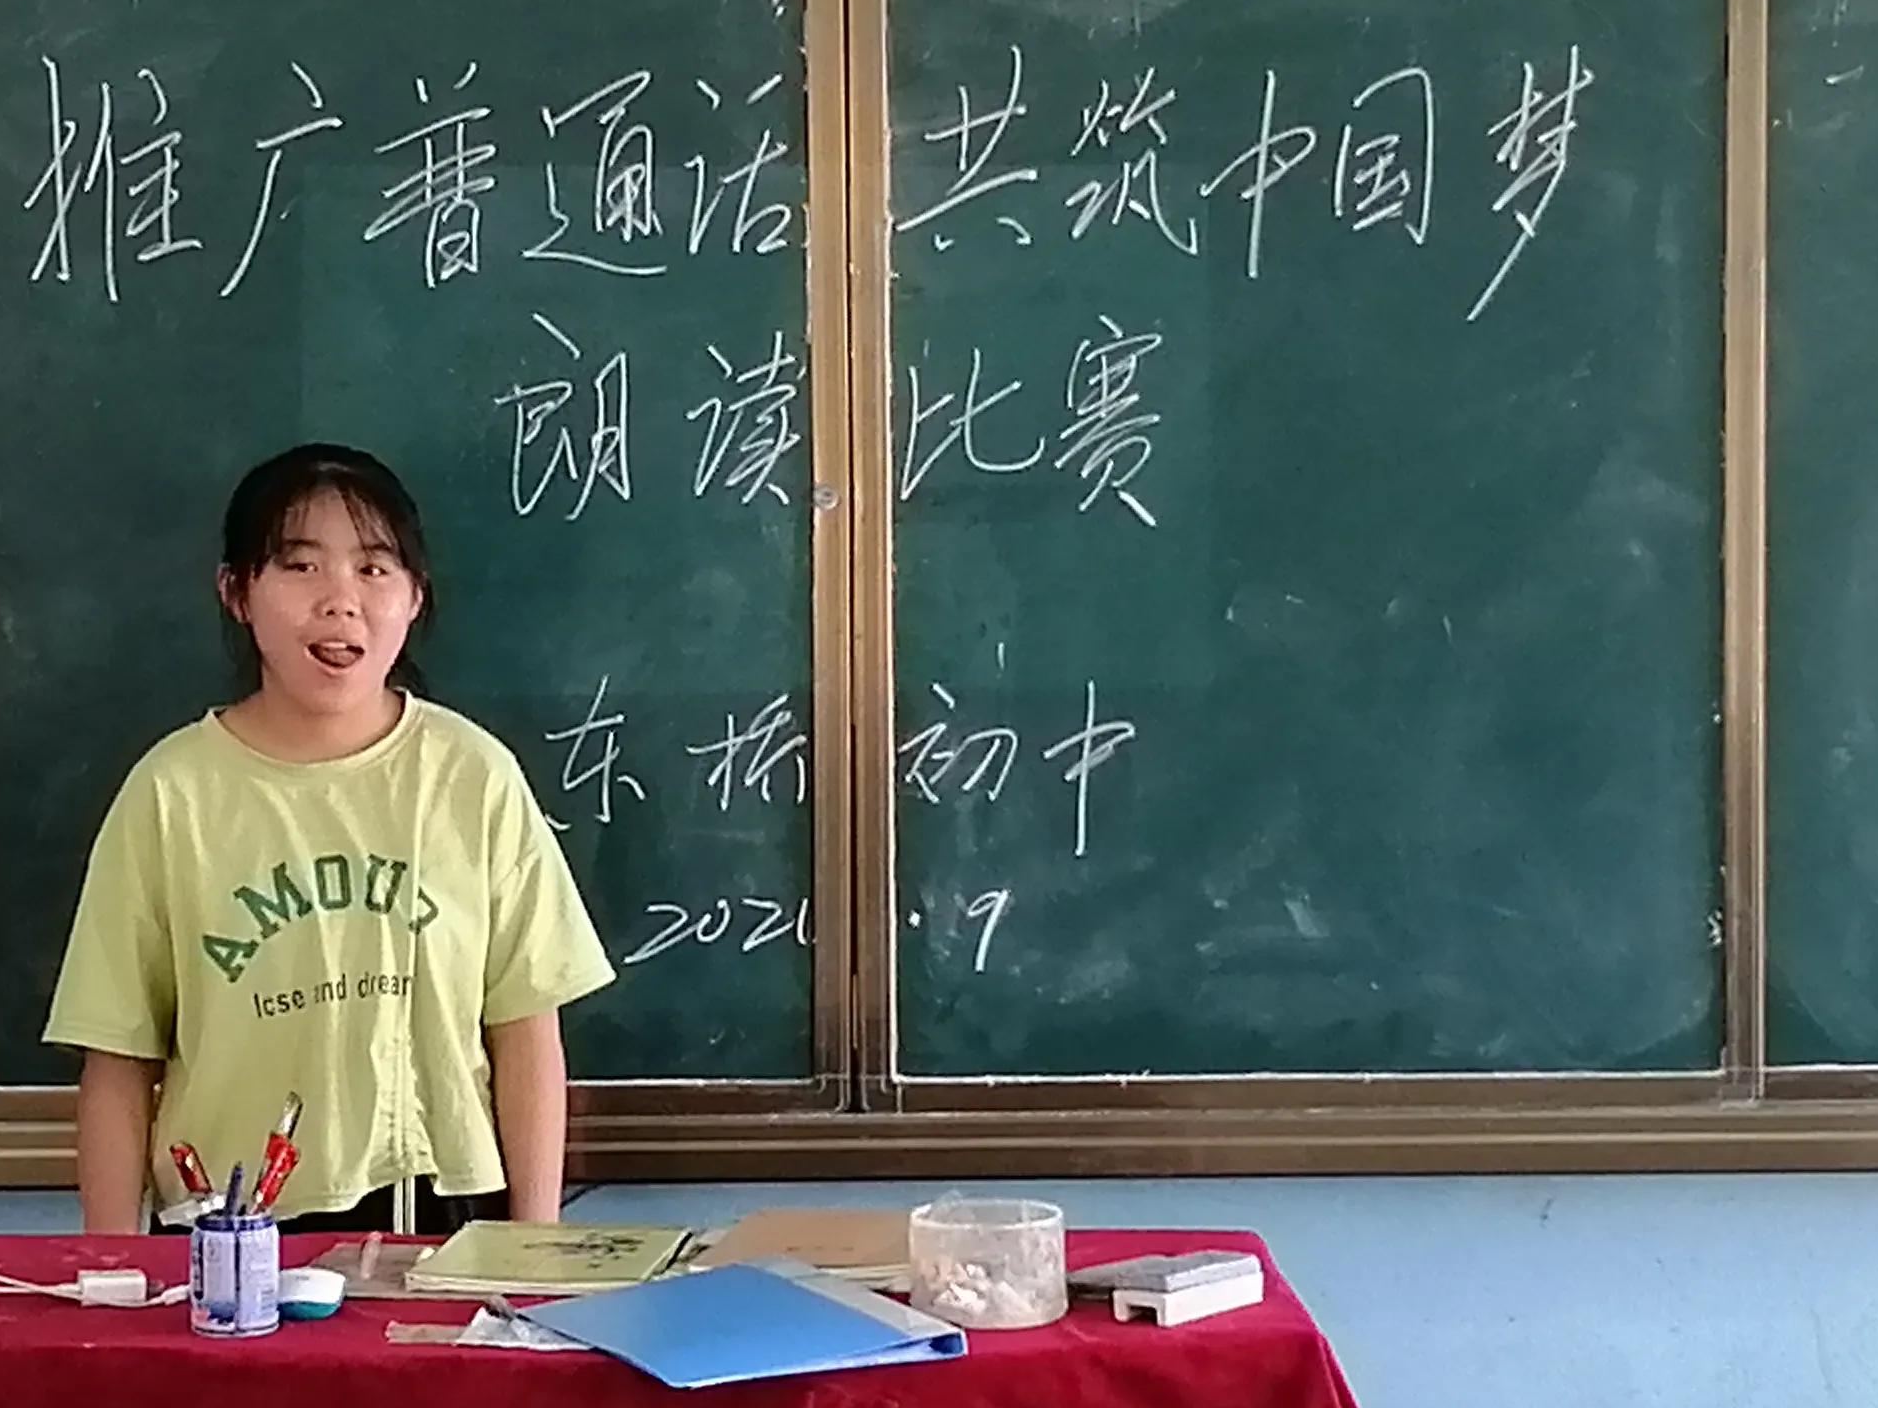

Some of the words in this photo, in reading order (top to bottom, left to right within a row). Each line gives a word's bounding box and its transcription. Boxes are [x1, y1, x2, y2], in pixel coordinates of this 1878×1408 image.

[24, 56, 791, 302] 推广普通话
[896, 44, 1596, 321] 共筑中国梦
